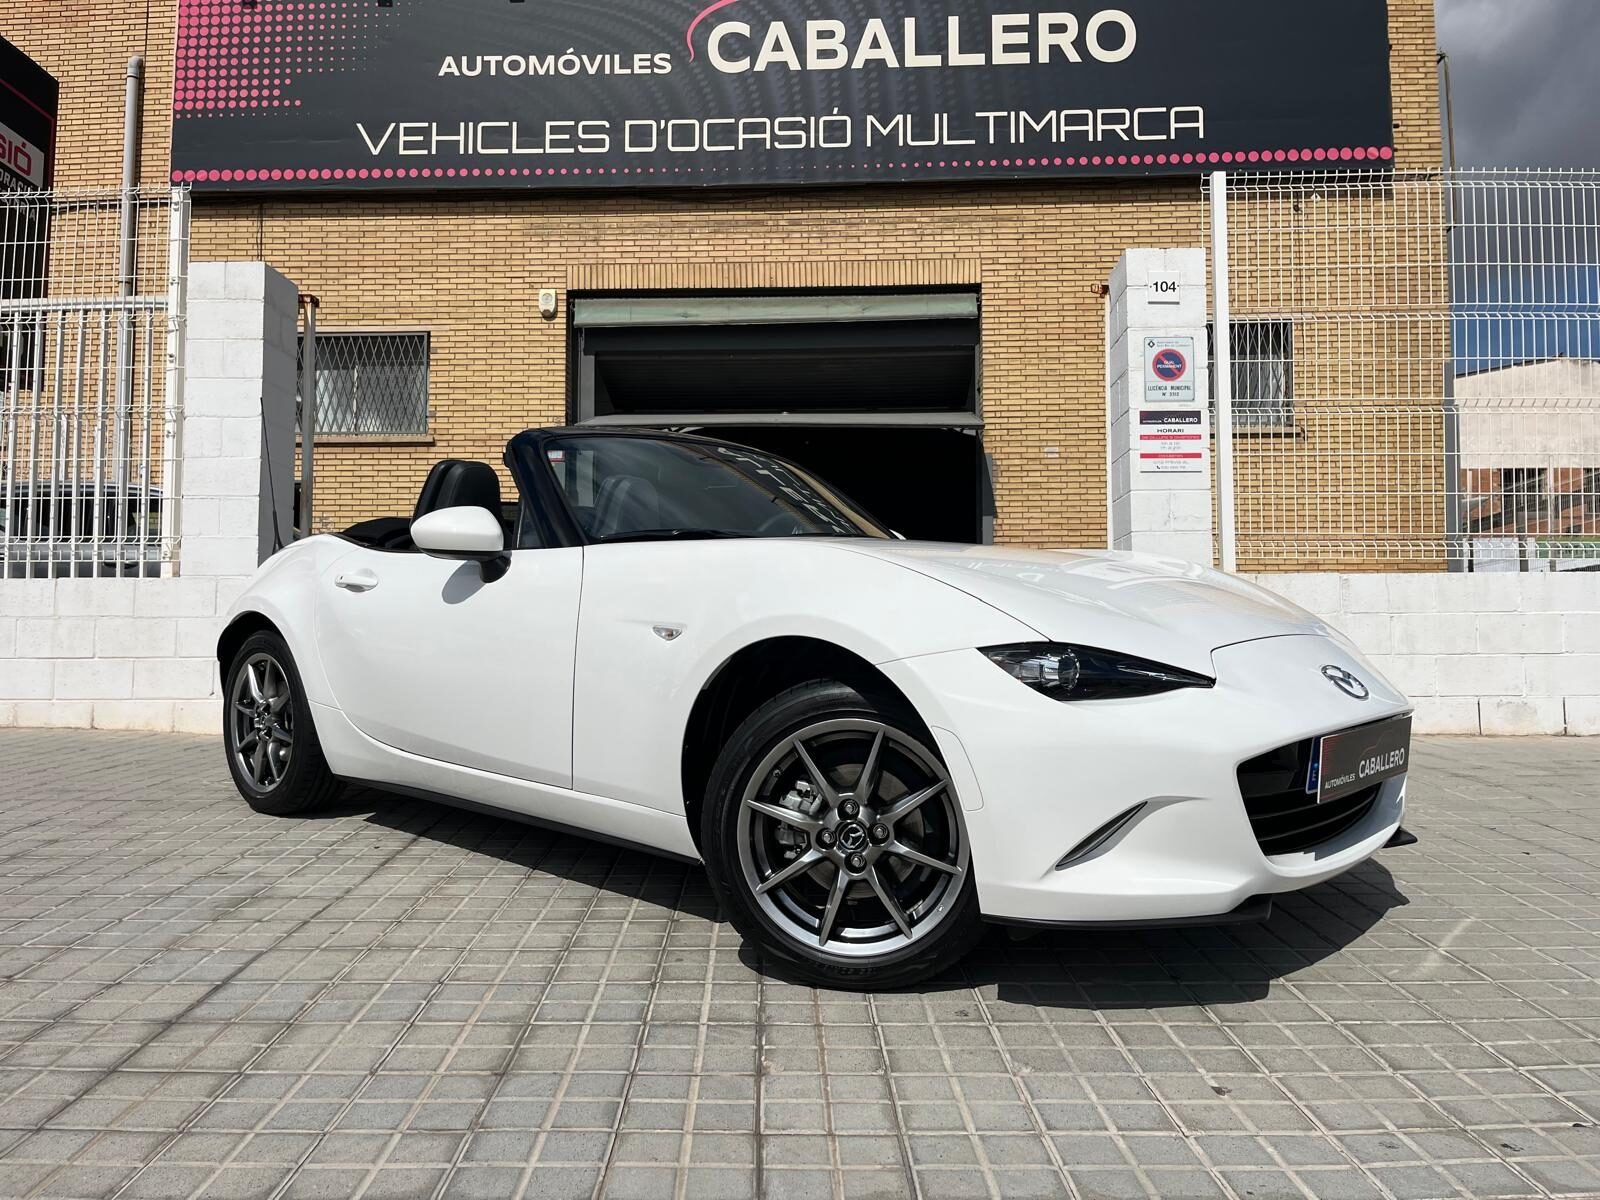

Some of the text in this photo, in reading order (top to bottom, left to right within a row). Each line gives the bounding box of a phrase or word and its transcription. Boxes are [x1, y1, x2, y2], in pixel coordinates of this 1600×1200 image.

[437, 7, 1138, 77] AUTOMÓVILES CABALLERO
[356, 105, 1205, 156] VEHICLES D'OCASIÓ MULTIMARCA
[1153, 281, 1177, 293] 104
[1358, 747, 1405, 778] CABALLERO
